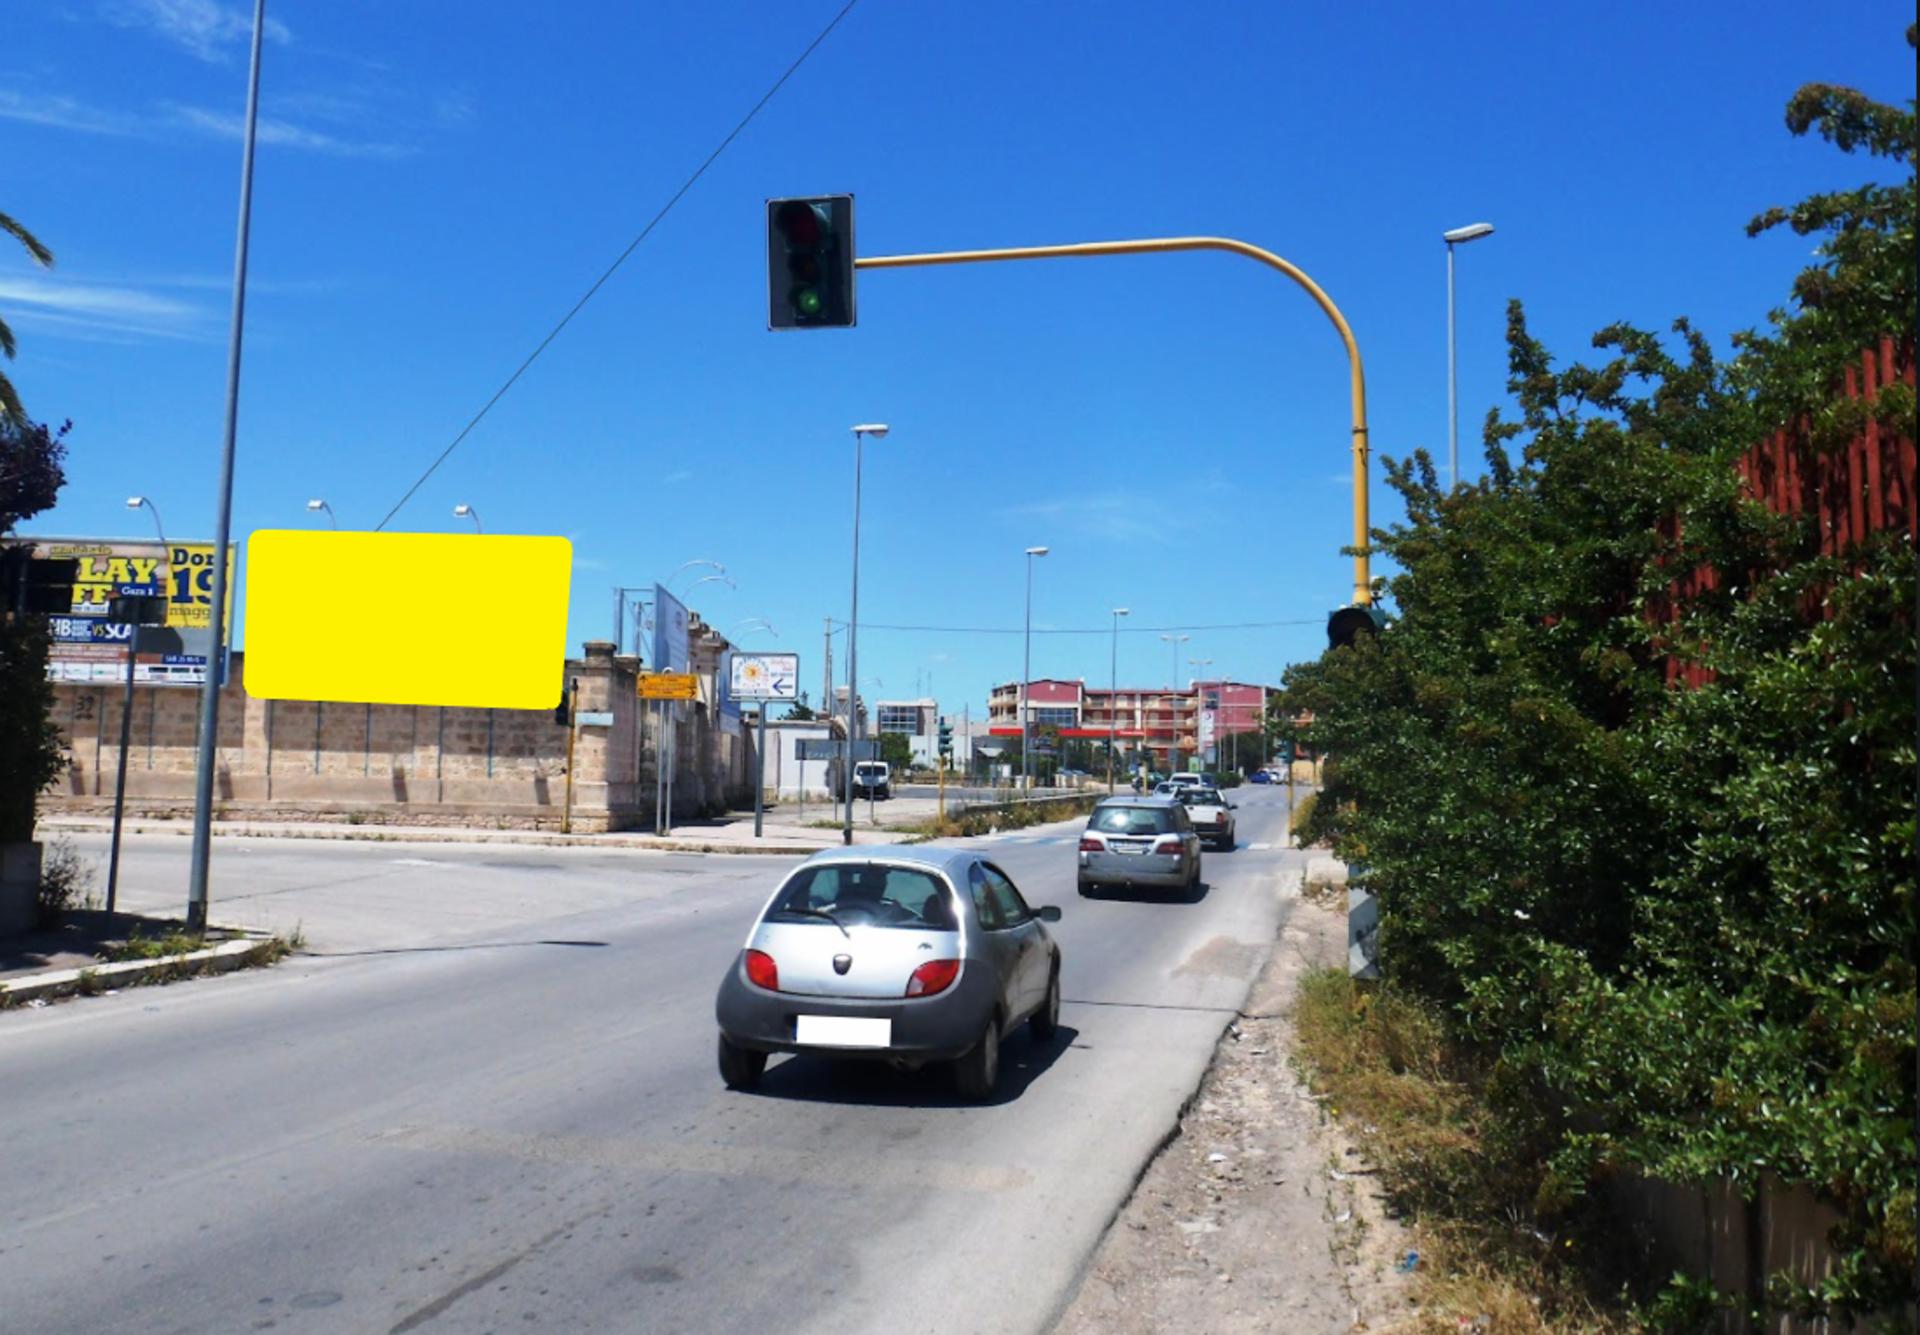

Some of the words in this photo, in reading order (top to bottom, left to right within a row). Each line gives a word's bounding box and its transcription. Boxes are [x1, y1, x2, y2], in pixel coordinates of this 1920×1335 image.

[50, 556, 158, 584] LAY
[71, 584, 112, 603] FF
[169, 607, 211, 620] magg
